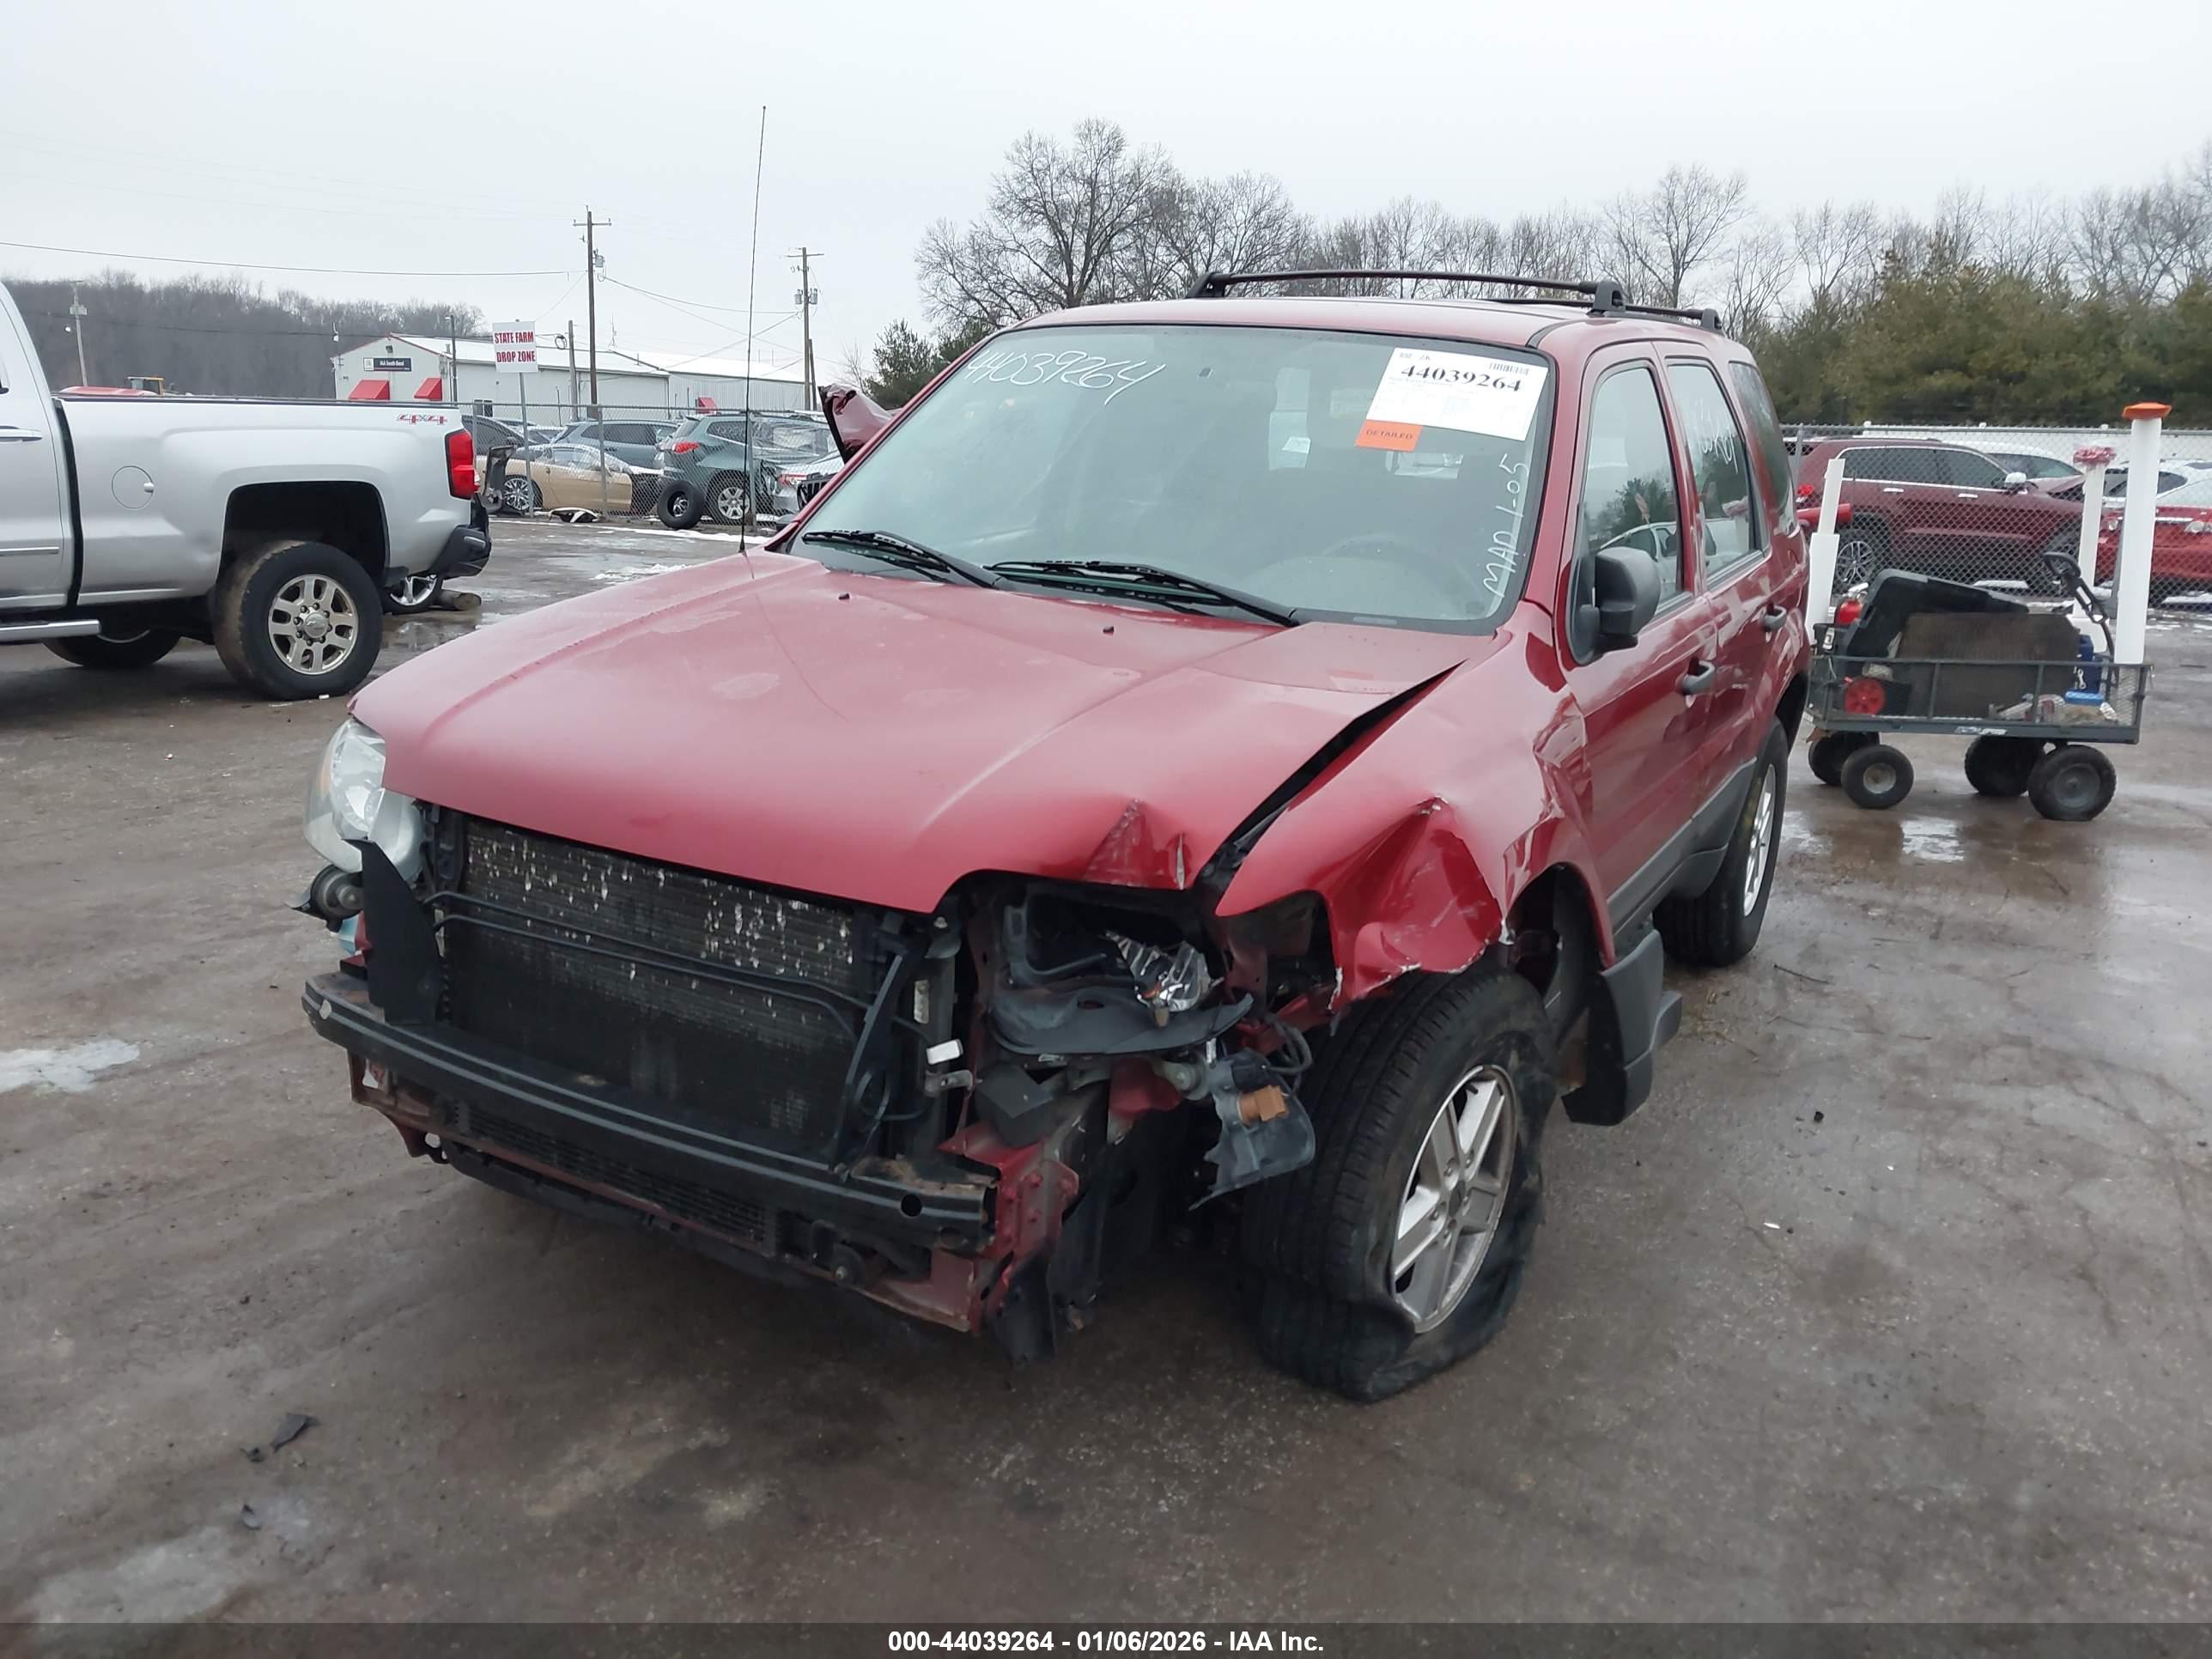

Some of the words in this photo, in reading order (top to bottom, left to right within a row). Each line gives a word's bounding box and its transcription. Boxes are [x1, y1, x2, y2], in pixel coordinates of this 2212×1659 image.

[494, 332, 514, 343] STATE
[515, 331, 534, 343] FARM
[496, 351, 516, 362] DROP
[517, 350, 536, 362] ZONE
[964, 349, 1166, 405] 44039264
[1401, 364, 1522, 392] 44039264
[1366, 429, 1413, 440] DETAILED
[1496, 453, 1530, 517] 1-05
